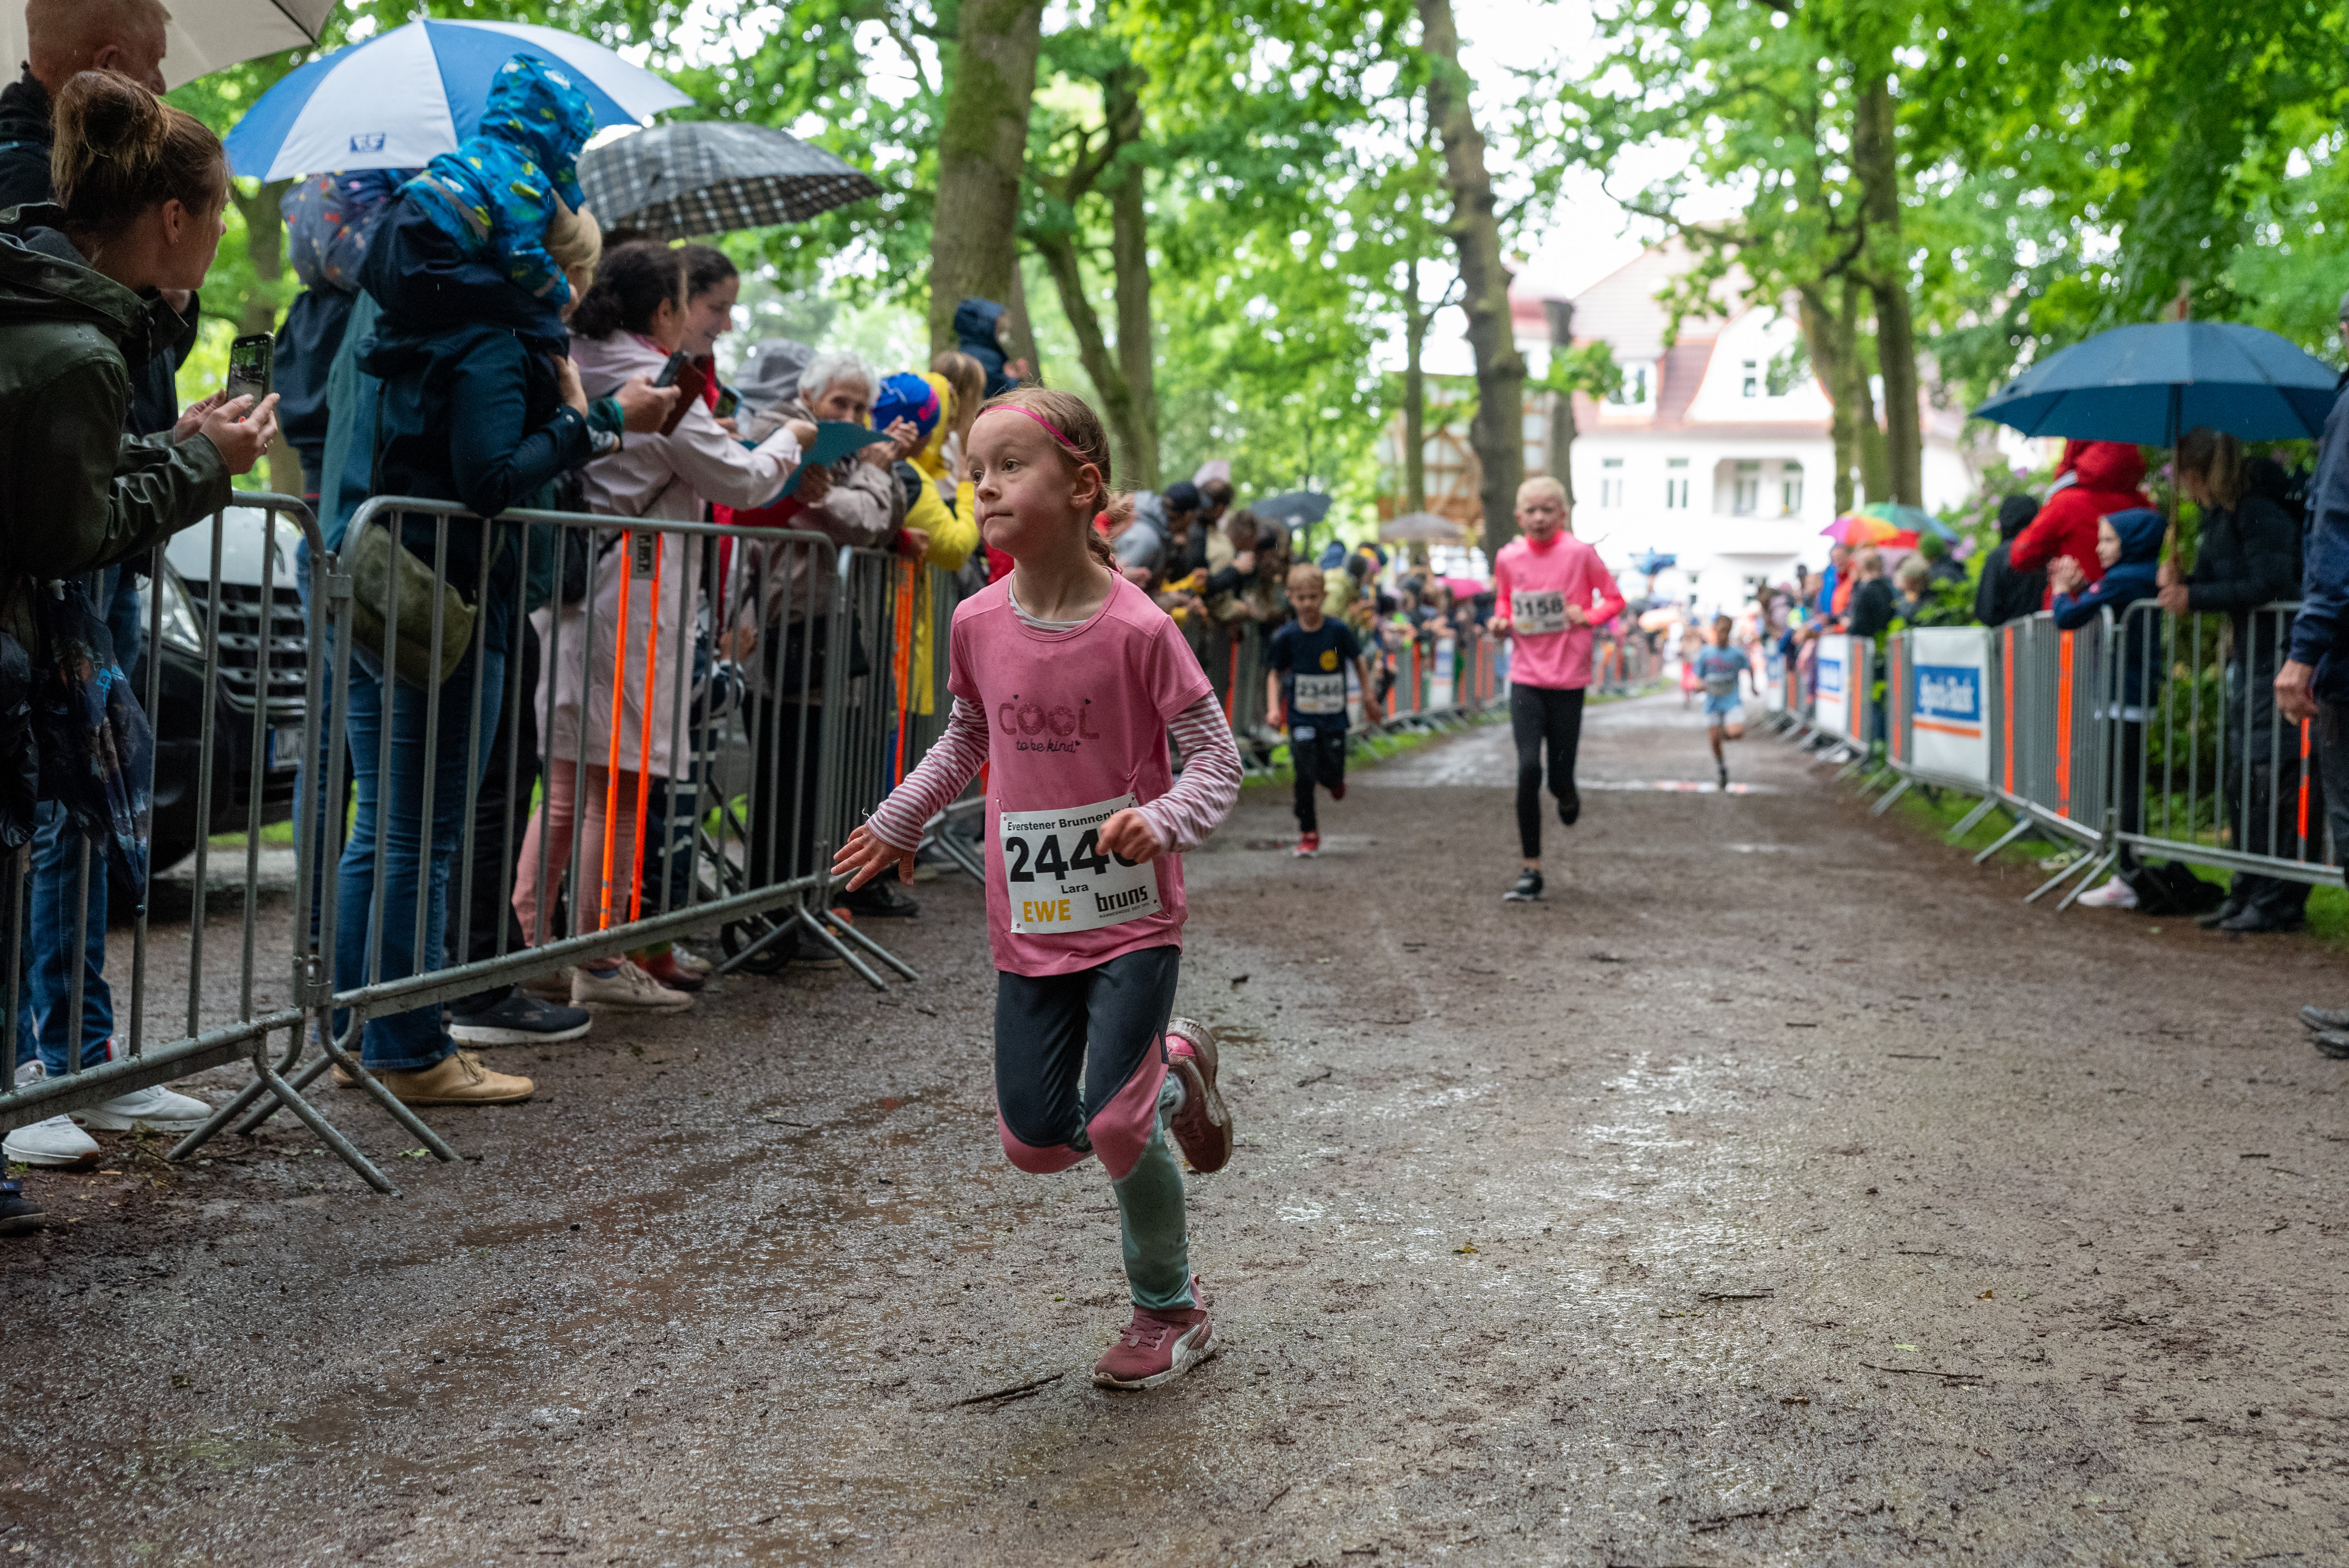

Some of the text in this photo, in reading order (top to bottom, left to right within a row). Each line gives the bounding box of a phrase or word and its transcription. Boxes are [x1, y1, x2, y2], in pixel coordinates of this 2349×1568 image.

[999, 703, 1100, 740] COOL
[1016, 739, 1076, 753] to be kind
[1007, 802, 1132, 831] Everstener Brunnenlf
[1005, 828, 1139, 882] 244
[1061, 884, 1089, 894] Lara
[1095, 886, 1148, 912] bruns
[1023, 899, 1071, 922] EWE
